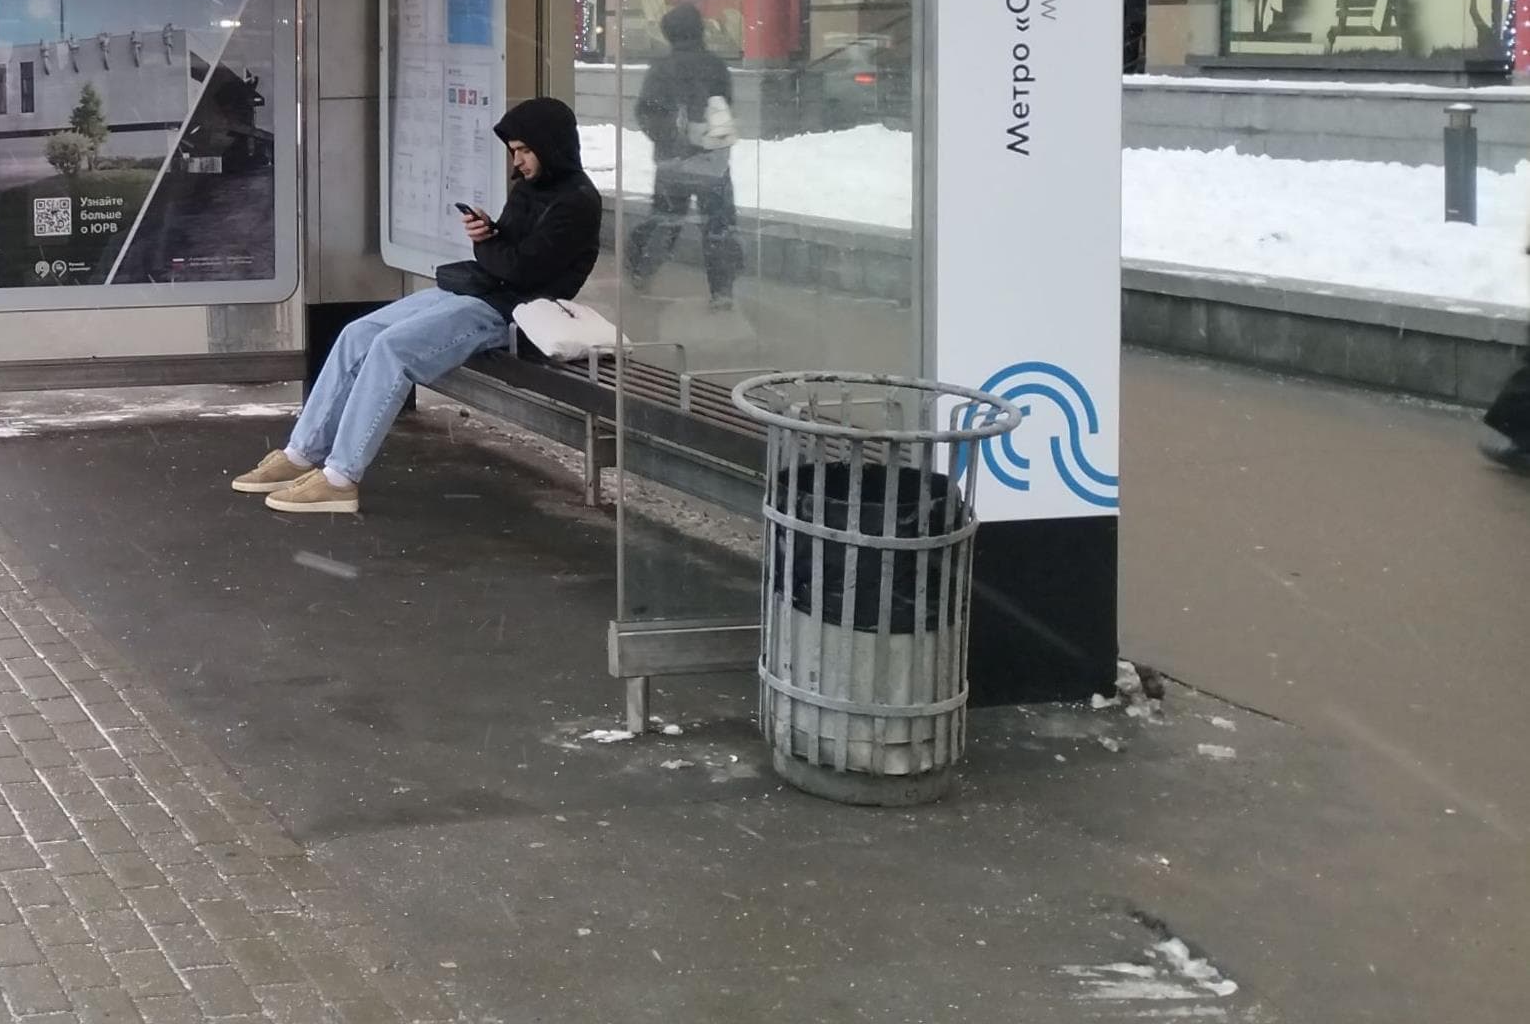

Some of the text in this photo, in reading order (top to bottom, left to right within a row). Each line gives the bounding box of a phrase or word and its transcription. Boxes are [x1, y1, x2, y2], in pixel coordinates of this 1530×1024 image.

[1006, 42, 1036, 156] Метро
[80, 196, 123, 207] Узнайте
[80, 209, 122, 220] больше
[80, 222, 118, 234] о ЮРВ
